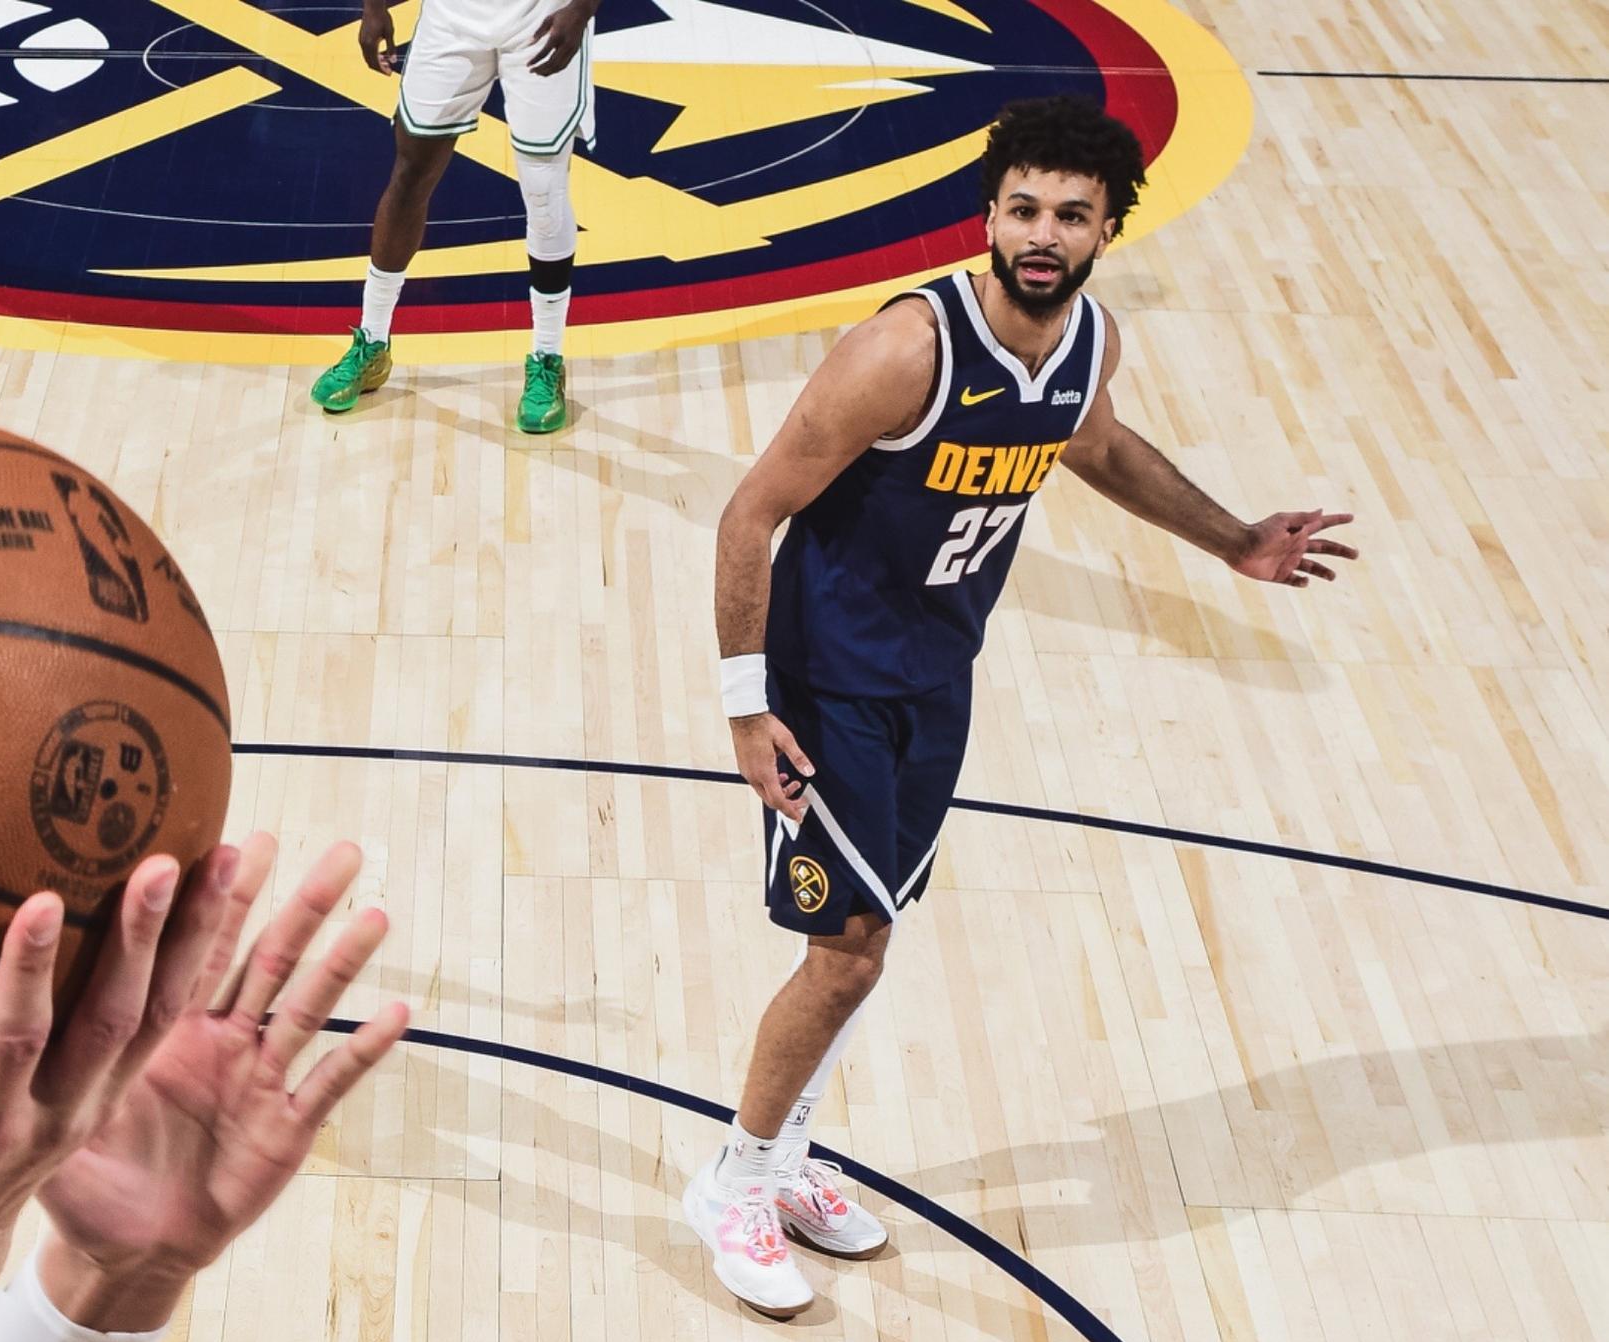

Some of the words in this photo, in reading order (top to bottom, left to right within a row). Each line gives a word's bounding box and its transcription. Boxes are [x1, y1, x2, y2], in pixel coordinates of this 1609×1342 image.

[1051, 389, 1081, 406] ibotta
[17, 508, 55, 533] BALL
[925, 503, 1028, 586] 27
